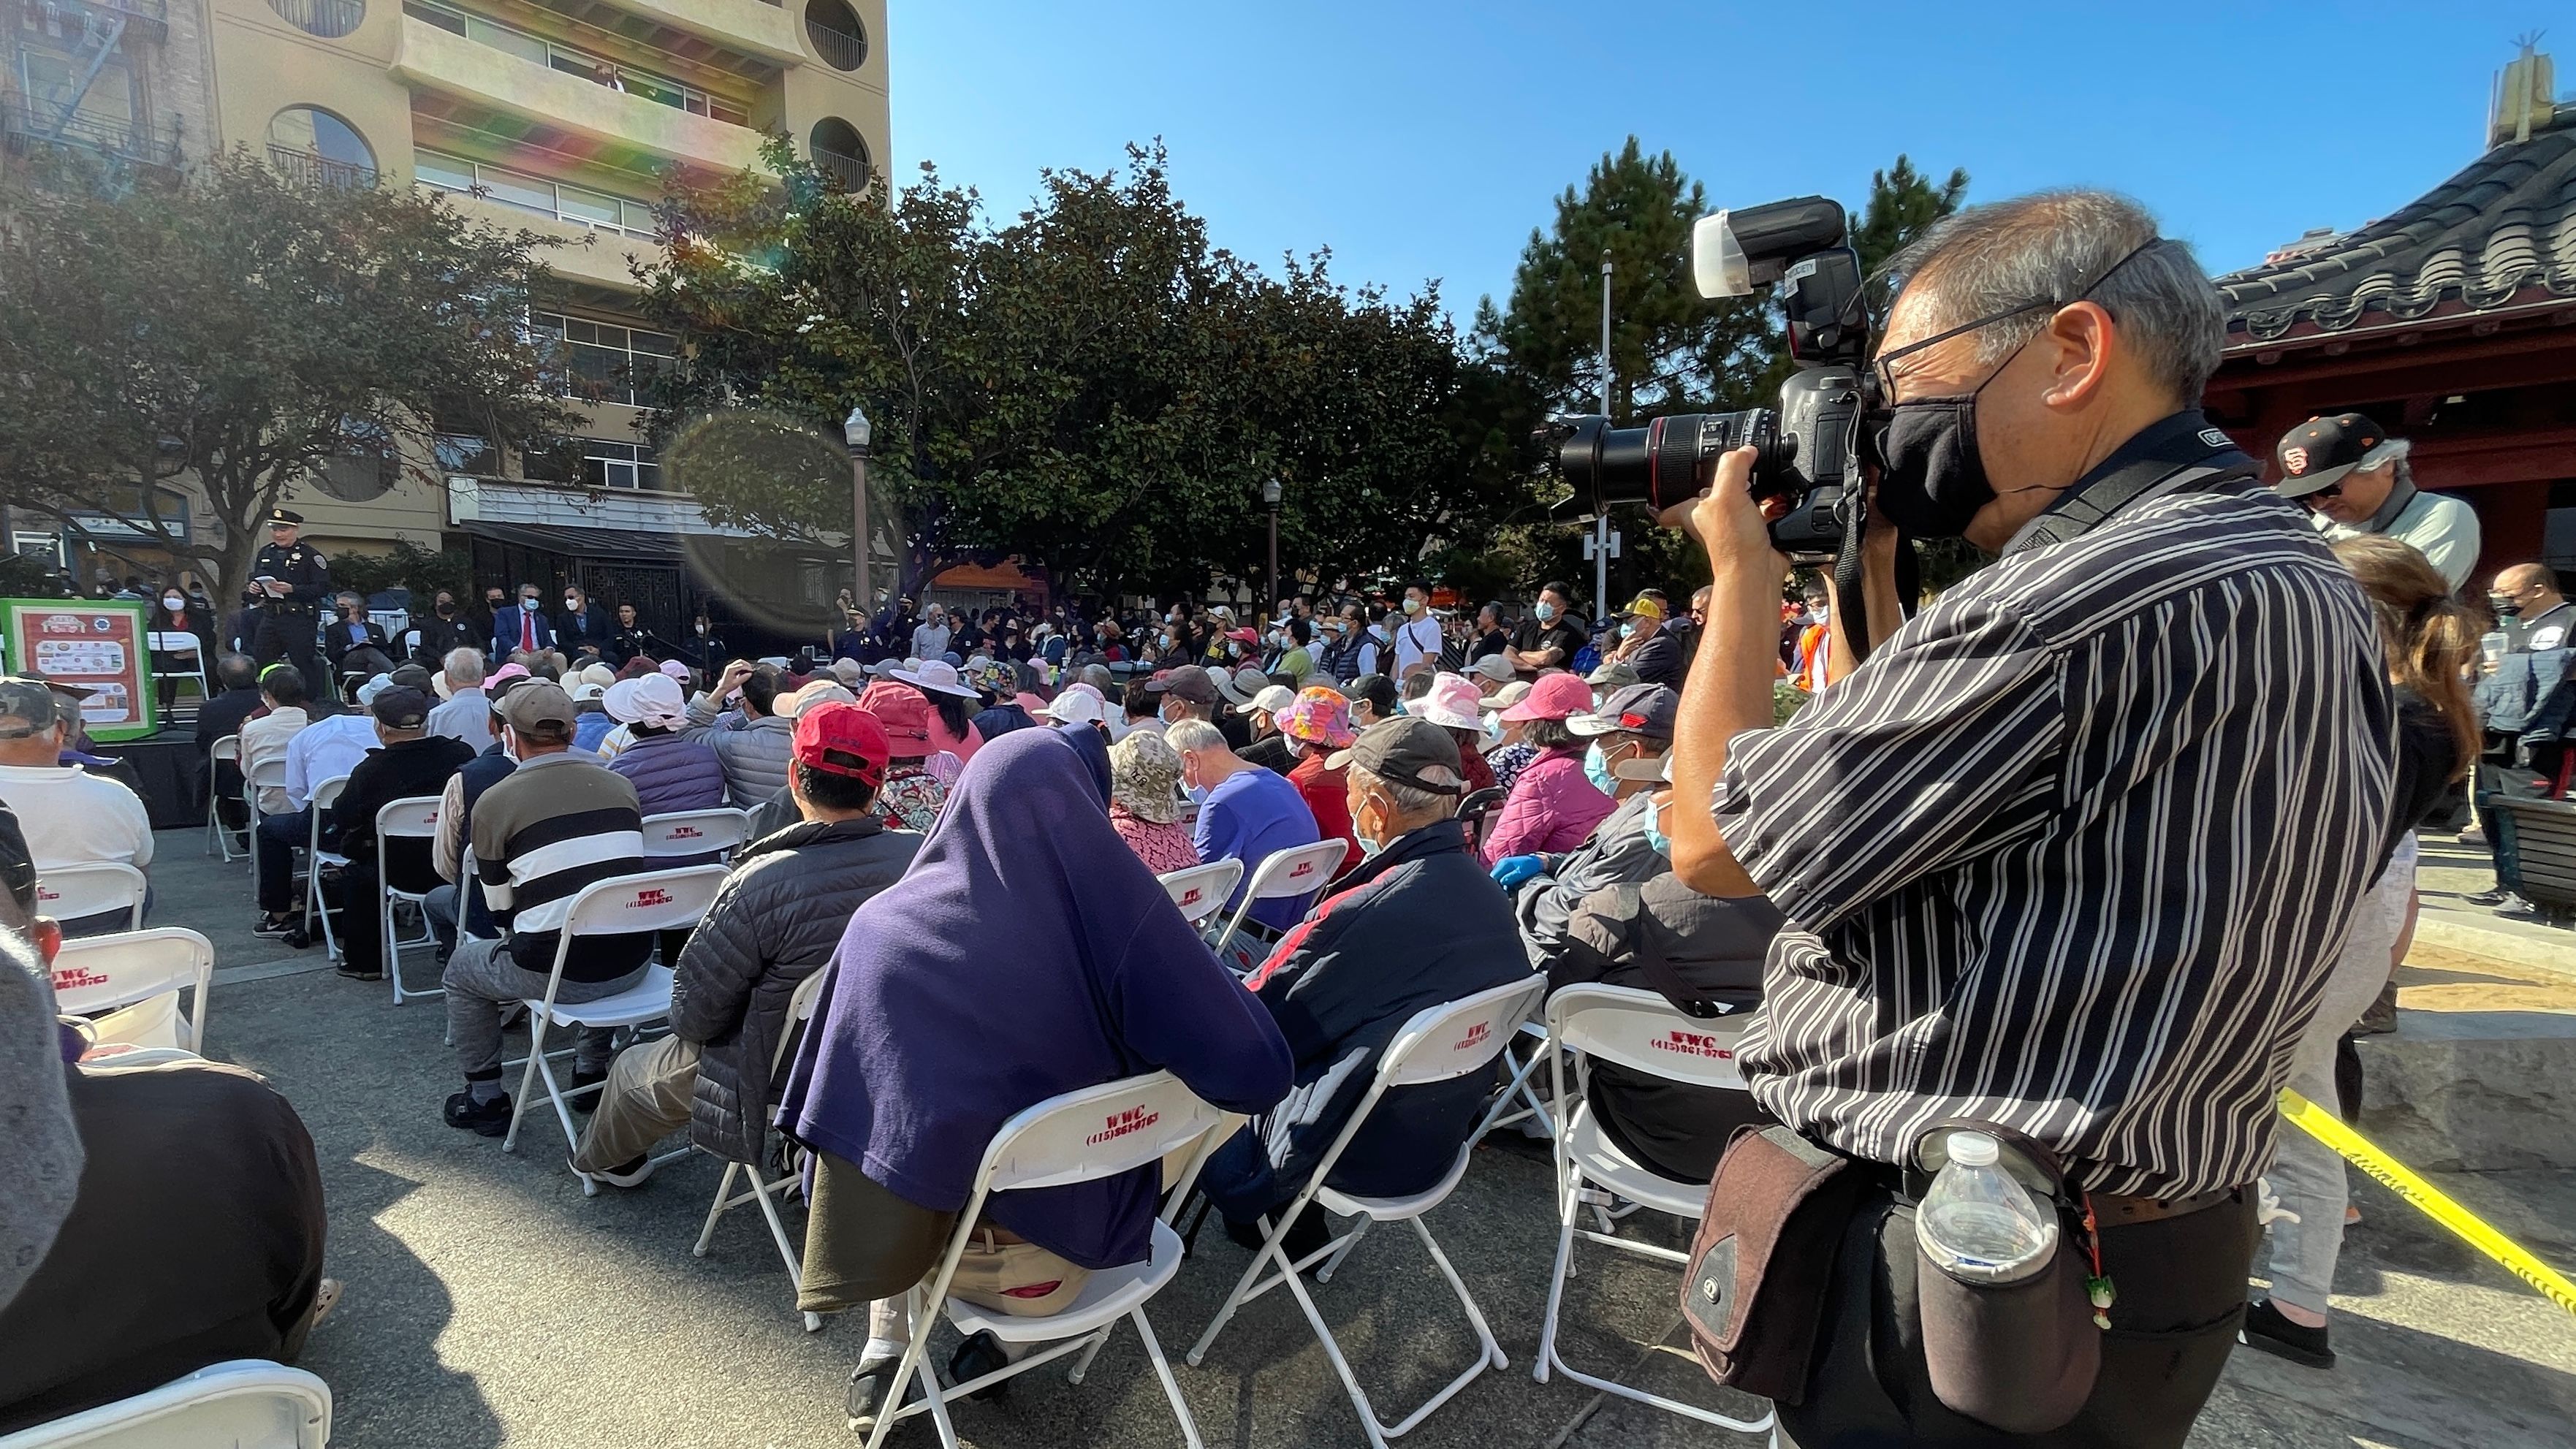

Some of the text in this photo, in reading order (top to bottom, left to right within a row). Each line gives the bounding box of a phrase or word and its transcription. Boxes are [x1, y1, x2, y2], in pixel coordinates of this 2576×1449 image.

[1651, 1038, 1733, 1060] (415)861-0763
[1671, 1031, 1716, 1048] WWC
[1106, 1104, 1145, 1129] WWC
[1086, 1111, 1159, 1146] (415)861-0763
